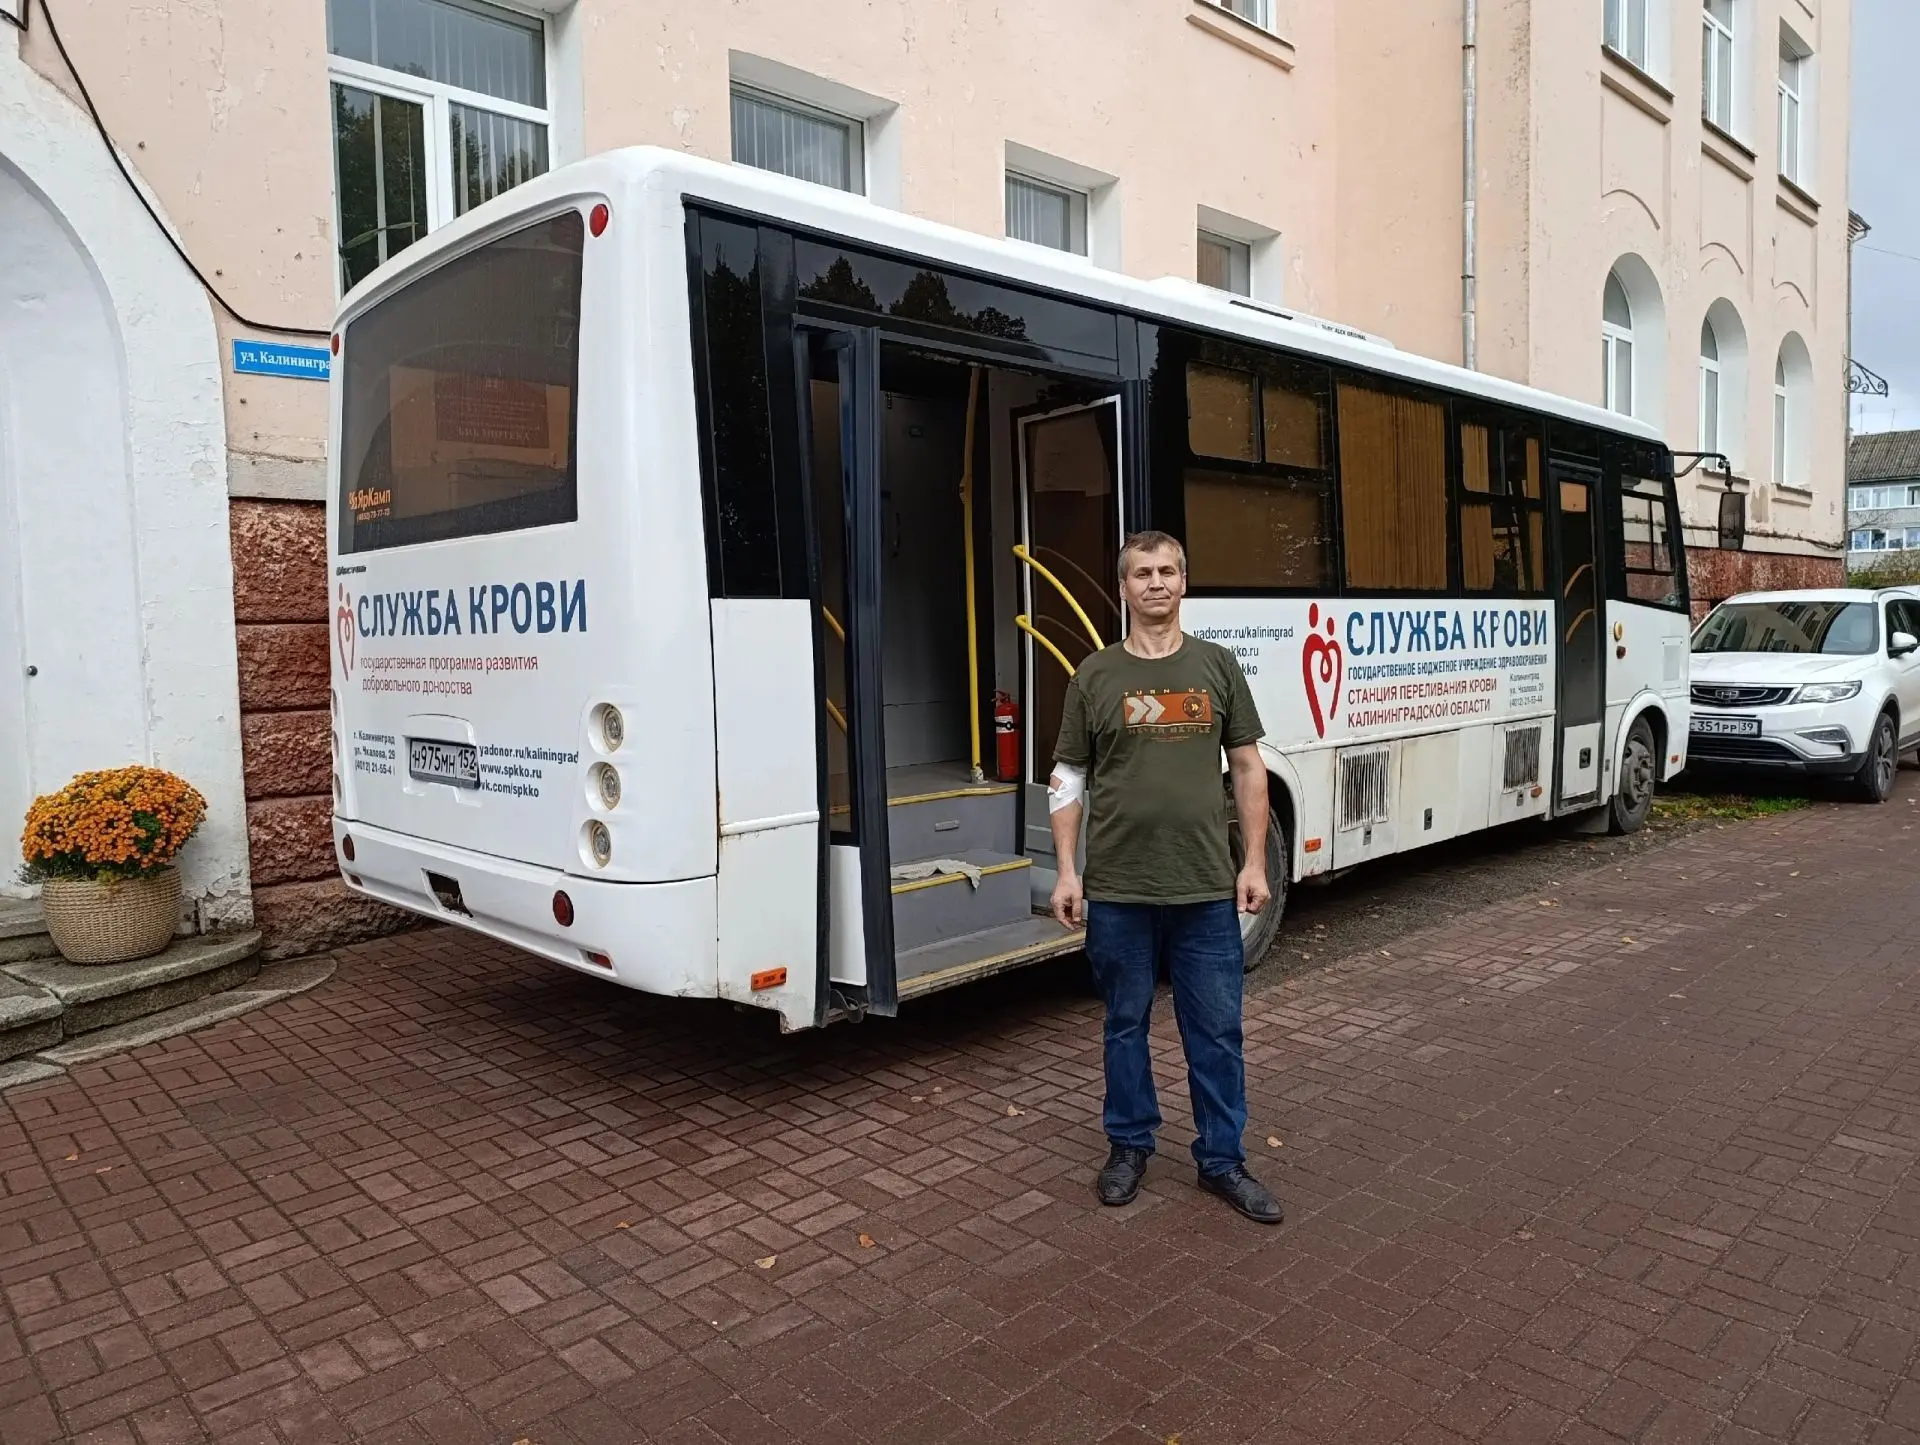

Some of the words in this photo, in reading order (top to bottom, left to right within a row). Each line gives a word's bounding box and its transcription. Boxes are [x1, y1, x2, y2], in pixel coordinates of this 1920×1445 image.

[240, 351, 258, 364] ул.
[357, 588, 462, 637] СЛУЖБА
[469, 579, 588, 635] КРОВИ
[1346, 611, 1467, 656] СЛУЖБА
[1473, 610, 1547, 648] КРОВИ
[361, 657, 427, 672] государственная
[429, 656, 483, 674] программа
[486, 656, 538, 674] развития
[1348, 662, 1416, 681] ГОСУДАРСТВЕННОЕ
[1417, 659, 1458, 676] БЮДЖЕТНОЕ
[1458, 657, 1498, 672] УЧРЕЖДЕНИЕ
[1498, 654, 1548, 669] ЗДРАВООХРАНЕНИЯ
[362, 676, 421, 694] добровольного
[422, 679, 472, 697] донорства
[1348, 685, 1398, 705] СТАНЦИЯ
[1399, 680, 1467, 700] ПЕРЕЛИВАНИЯ
[1469, 678, 1498, 695] КРОВИ
[1348, 700, 1449, 728] КАЛИНИНГРАДСКОЙ
[1450, 699, 1491, 716] ОБЛАСТИ
[1741, 722, 1754, 731] 39
[358, 730, 396, 745] Калининград
[414, 745, 456, 774] Н975МН
[458, 749, 476, 770] 152
[479, 744, 579, 764] yadonor.ru/kaliningrad
[480, 764, 542, 779] www.spkko.ru
